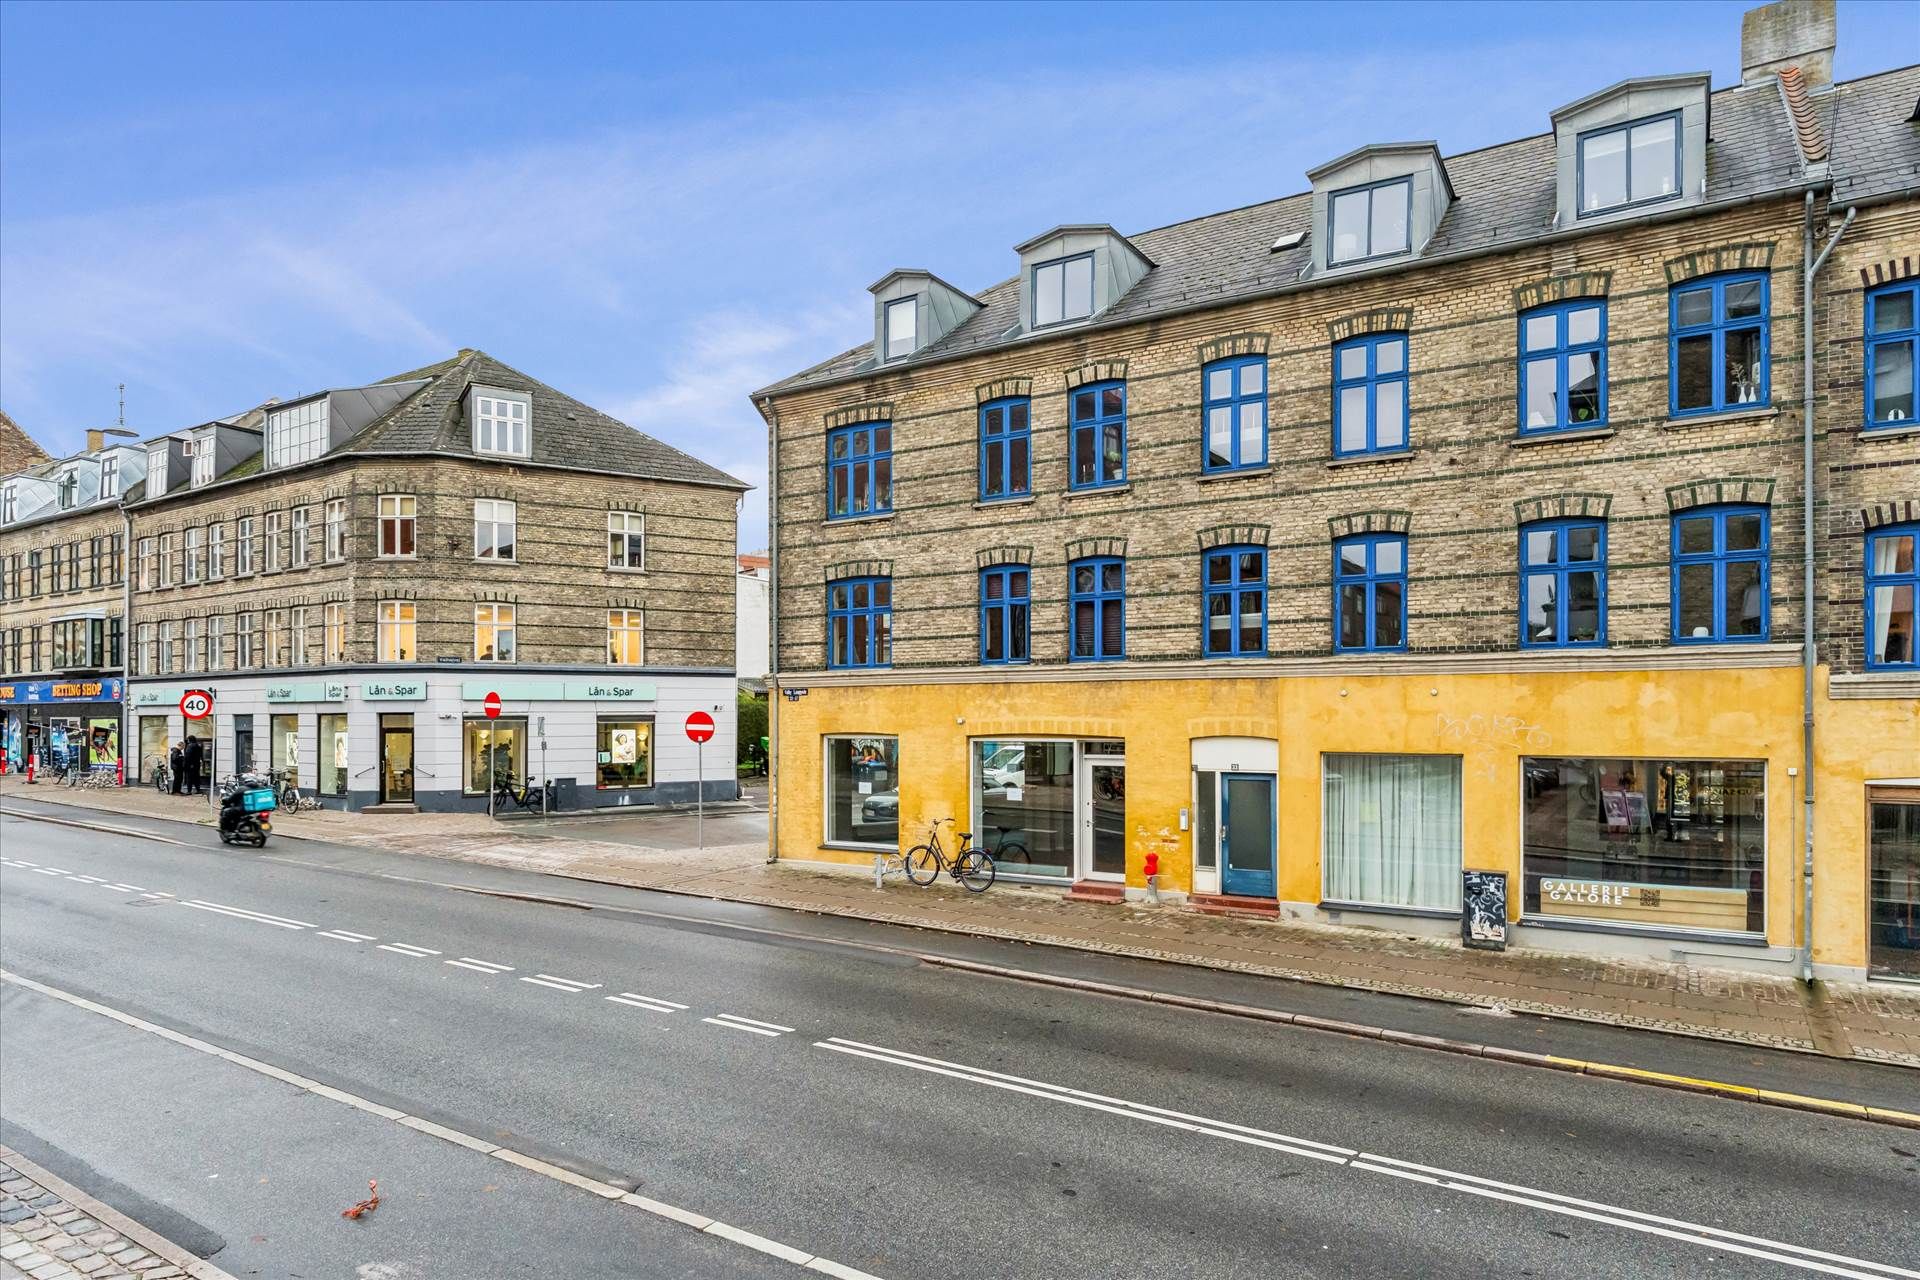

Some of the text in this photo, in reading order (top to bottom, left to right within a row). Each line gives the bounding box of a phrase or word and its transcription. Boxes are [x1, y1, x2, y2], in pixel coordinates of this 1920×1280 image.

[52, 683, 81, 697] BETTING
[82, 682, 102, 696] SHOP
[369, 684, 386, 695] Lån
[395, 685, 417, 697] Spar
[588, 686, 604, 696] Lån
[613, 686, 634, 698] Spar
[185, 700, 206, 711] 40
[1543, 880, 1630, 897] GALLERIE
[1549, 890, 1623, 905] GALORE
